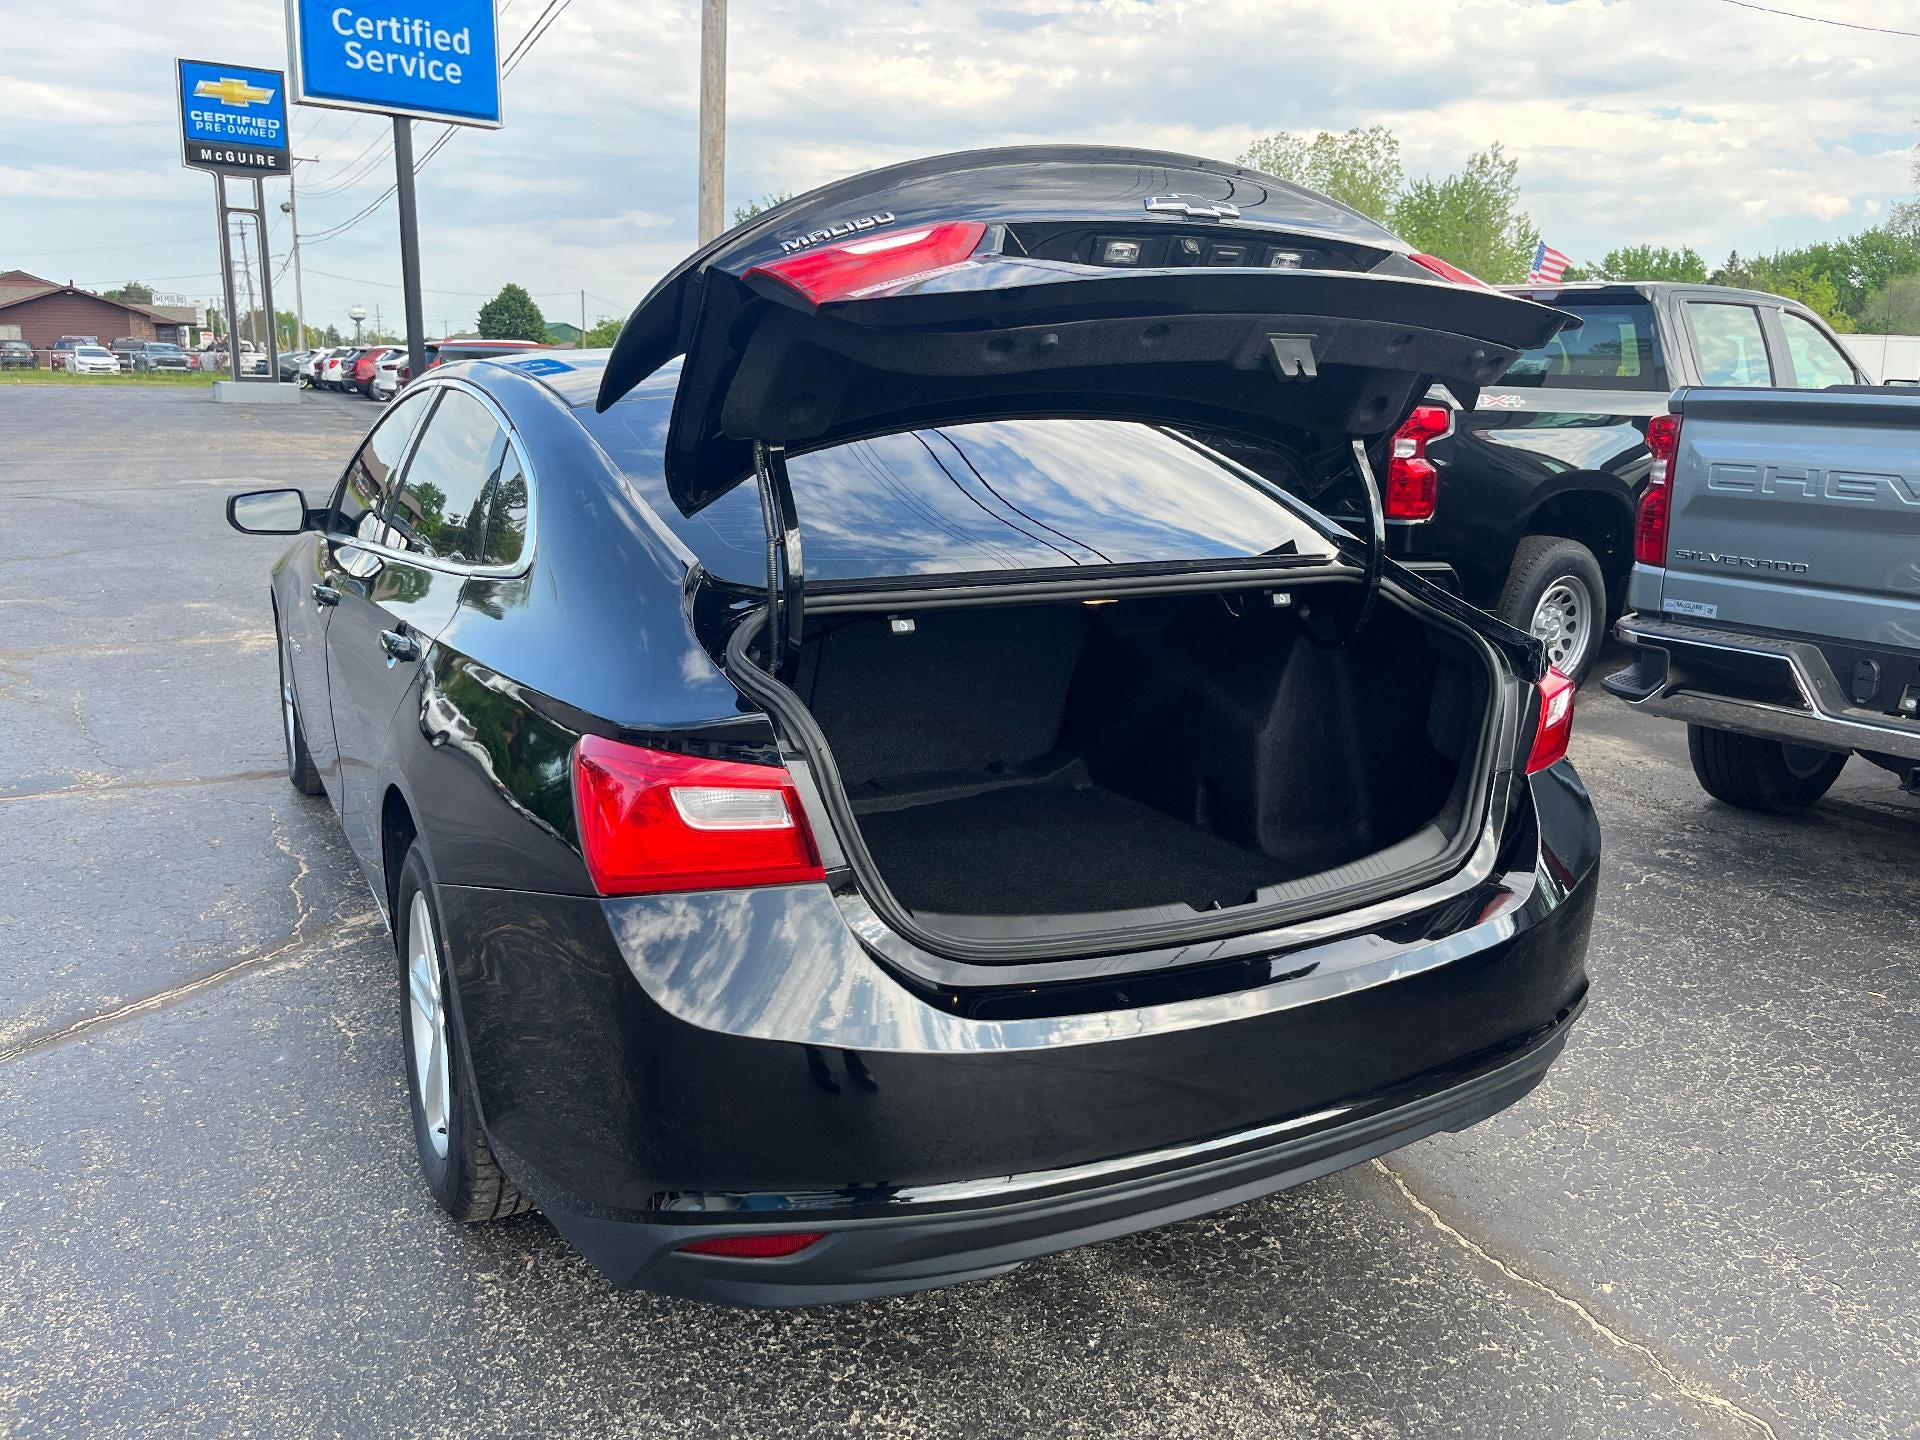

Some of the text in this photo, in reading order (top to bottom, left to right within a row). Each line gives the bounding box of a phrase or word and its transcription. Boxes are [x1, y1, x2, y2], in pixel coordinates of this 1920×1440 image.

[332, 7, 471, 55] Certified
[344, 41, 463, 84] Service
[190, 110, 280, 129] CERTIFIED
[195, 121, 277, 139] PRE-OWNED
[200, 149, 276, 167] McGUIRE
[779, 211, 896, 255] MALIBU
[1675, 549, 1809, 573] SILVERADO
